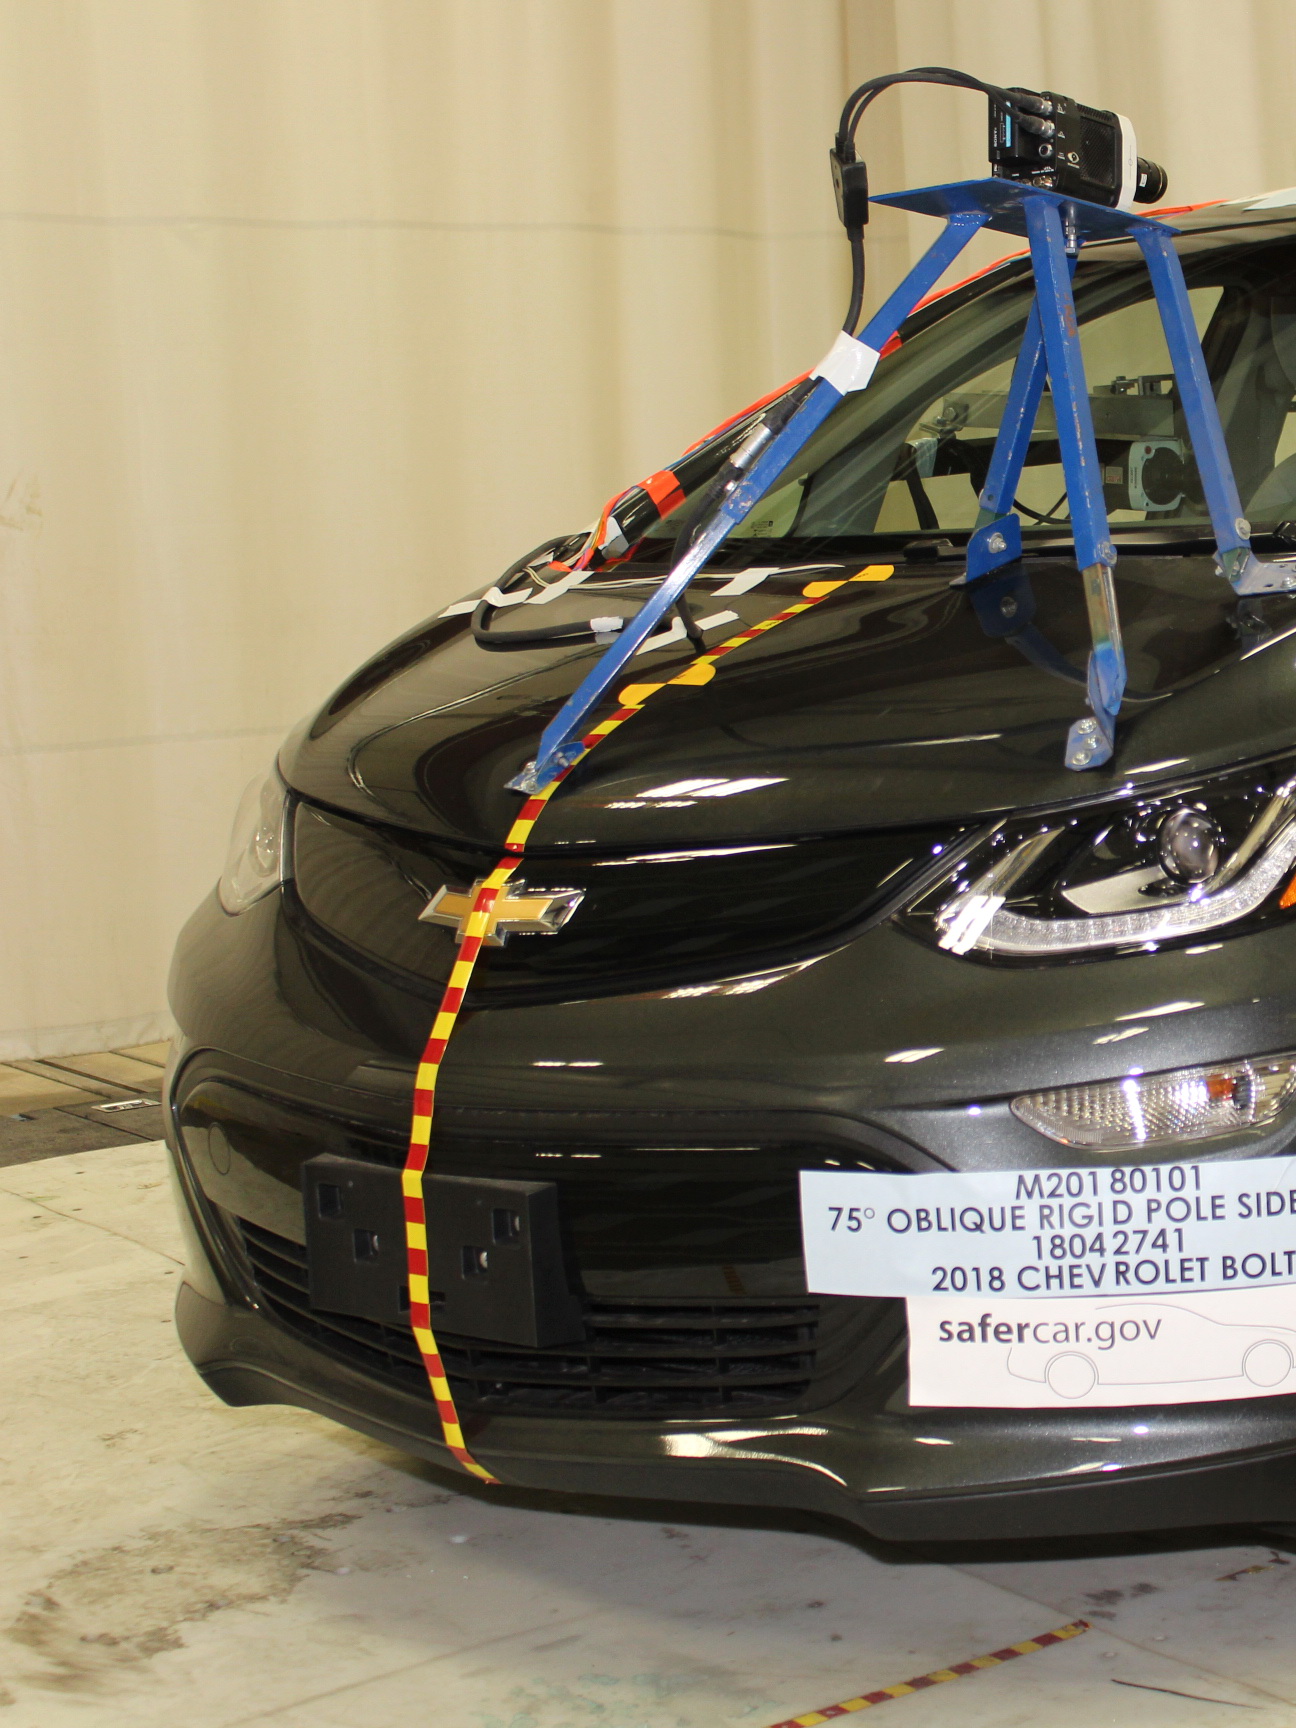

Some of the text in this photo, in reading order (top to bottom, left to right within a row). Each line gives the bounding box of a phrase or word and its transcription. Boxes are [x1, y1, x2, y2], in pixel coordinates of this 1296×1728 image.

[1015, 1164, 1202, 1201] M20180101
[886, 1205, 1026, 1234] OBLIQUE
[1038, 1200, 1134, 1231] RIGID
[1146, 1194, 1227, 1225] POLE
[1032, 1227, 1184, 1261] 18042741
[931, 1265, 1006, 1293] 2018
[1016, 1256, 1210, 1291] CHEVROLET
[938, 1312, 1163, 1351] safercar.gov
